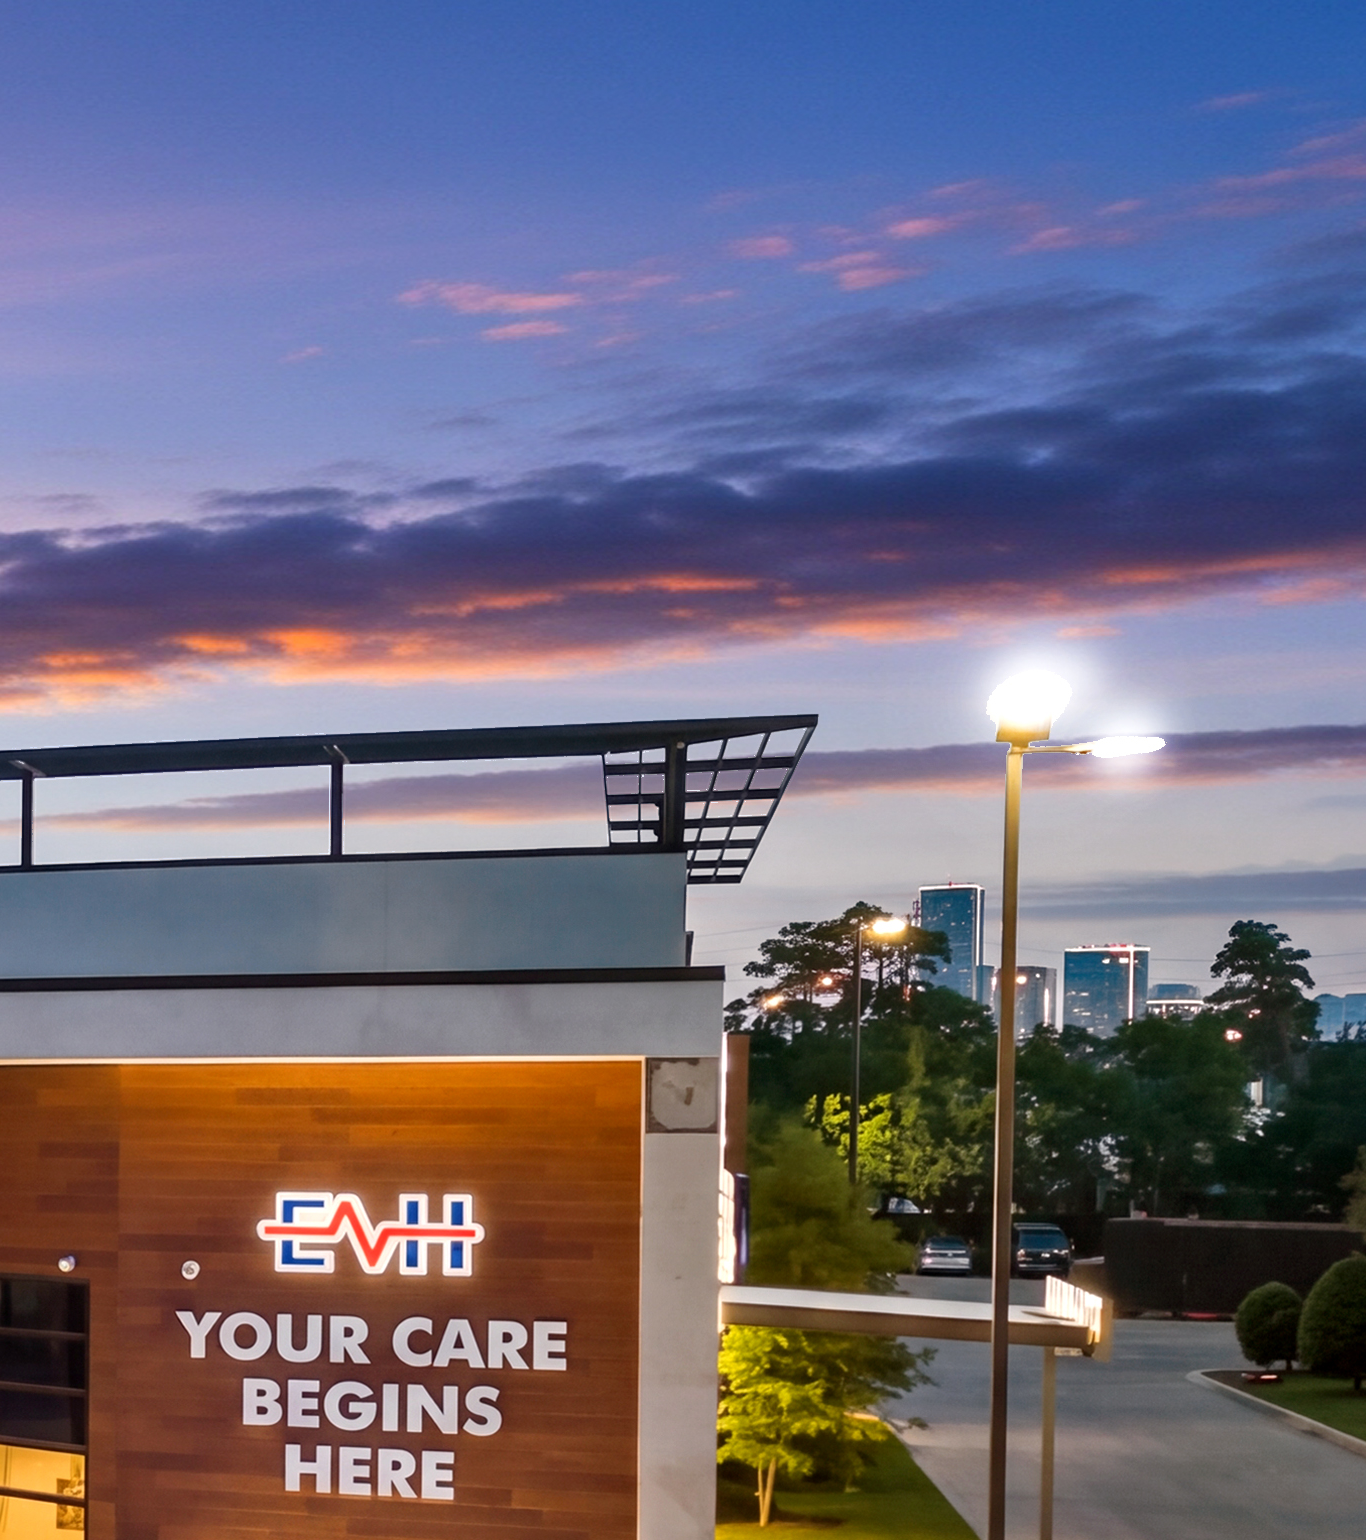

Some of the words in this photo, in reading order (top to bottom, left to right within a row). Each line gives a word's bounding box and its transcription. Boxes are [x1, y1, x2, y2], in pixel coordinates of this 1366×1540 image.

[175, 1310, 370, 1364] YOUR
[392, 1317, 568, 1371] CARE
[243, 1378, 503, 1437] BEGINS
[285, 1444, 455, 1501] HERE
